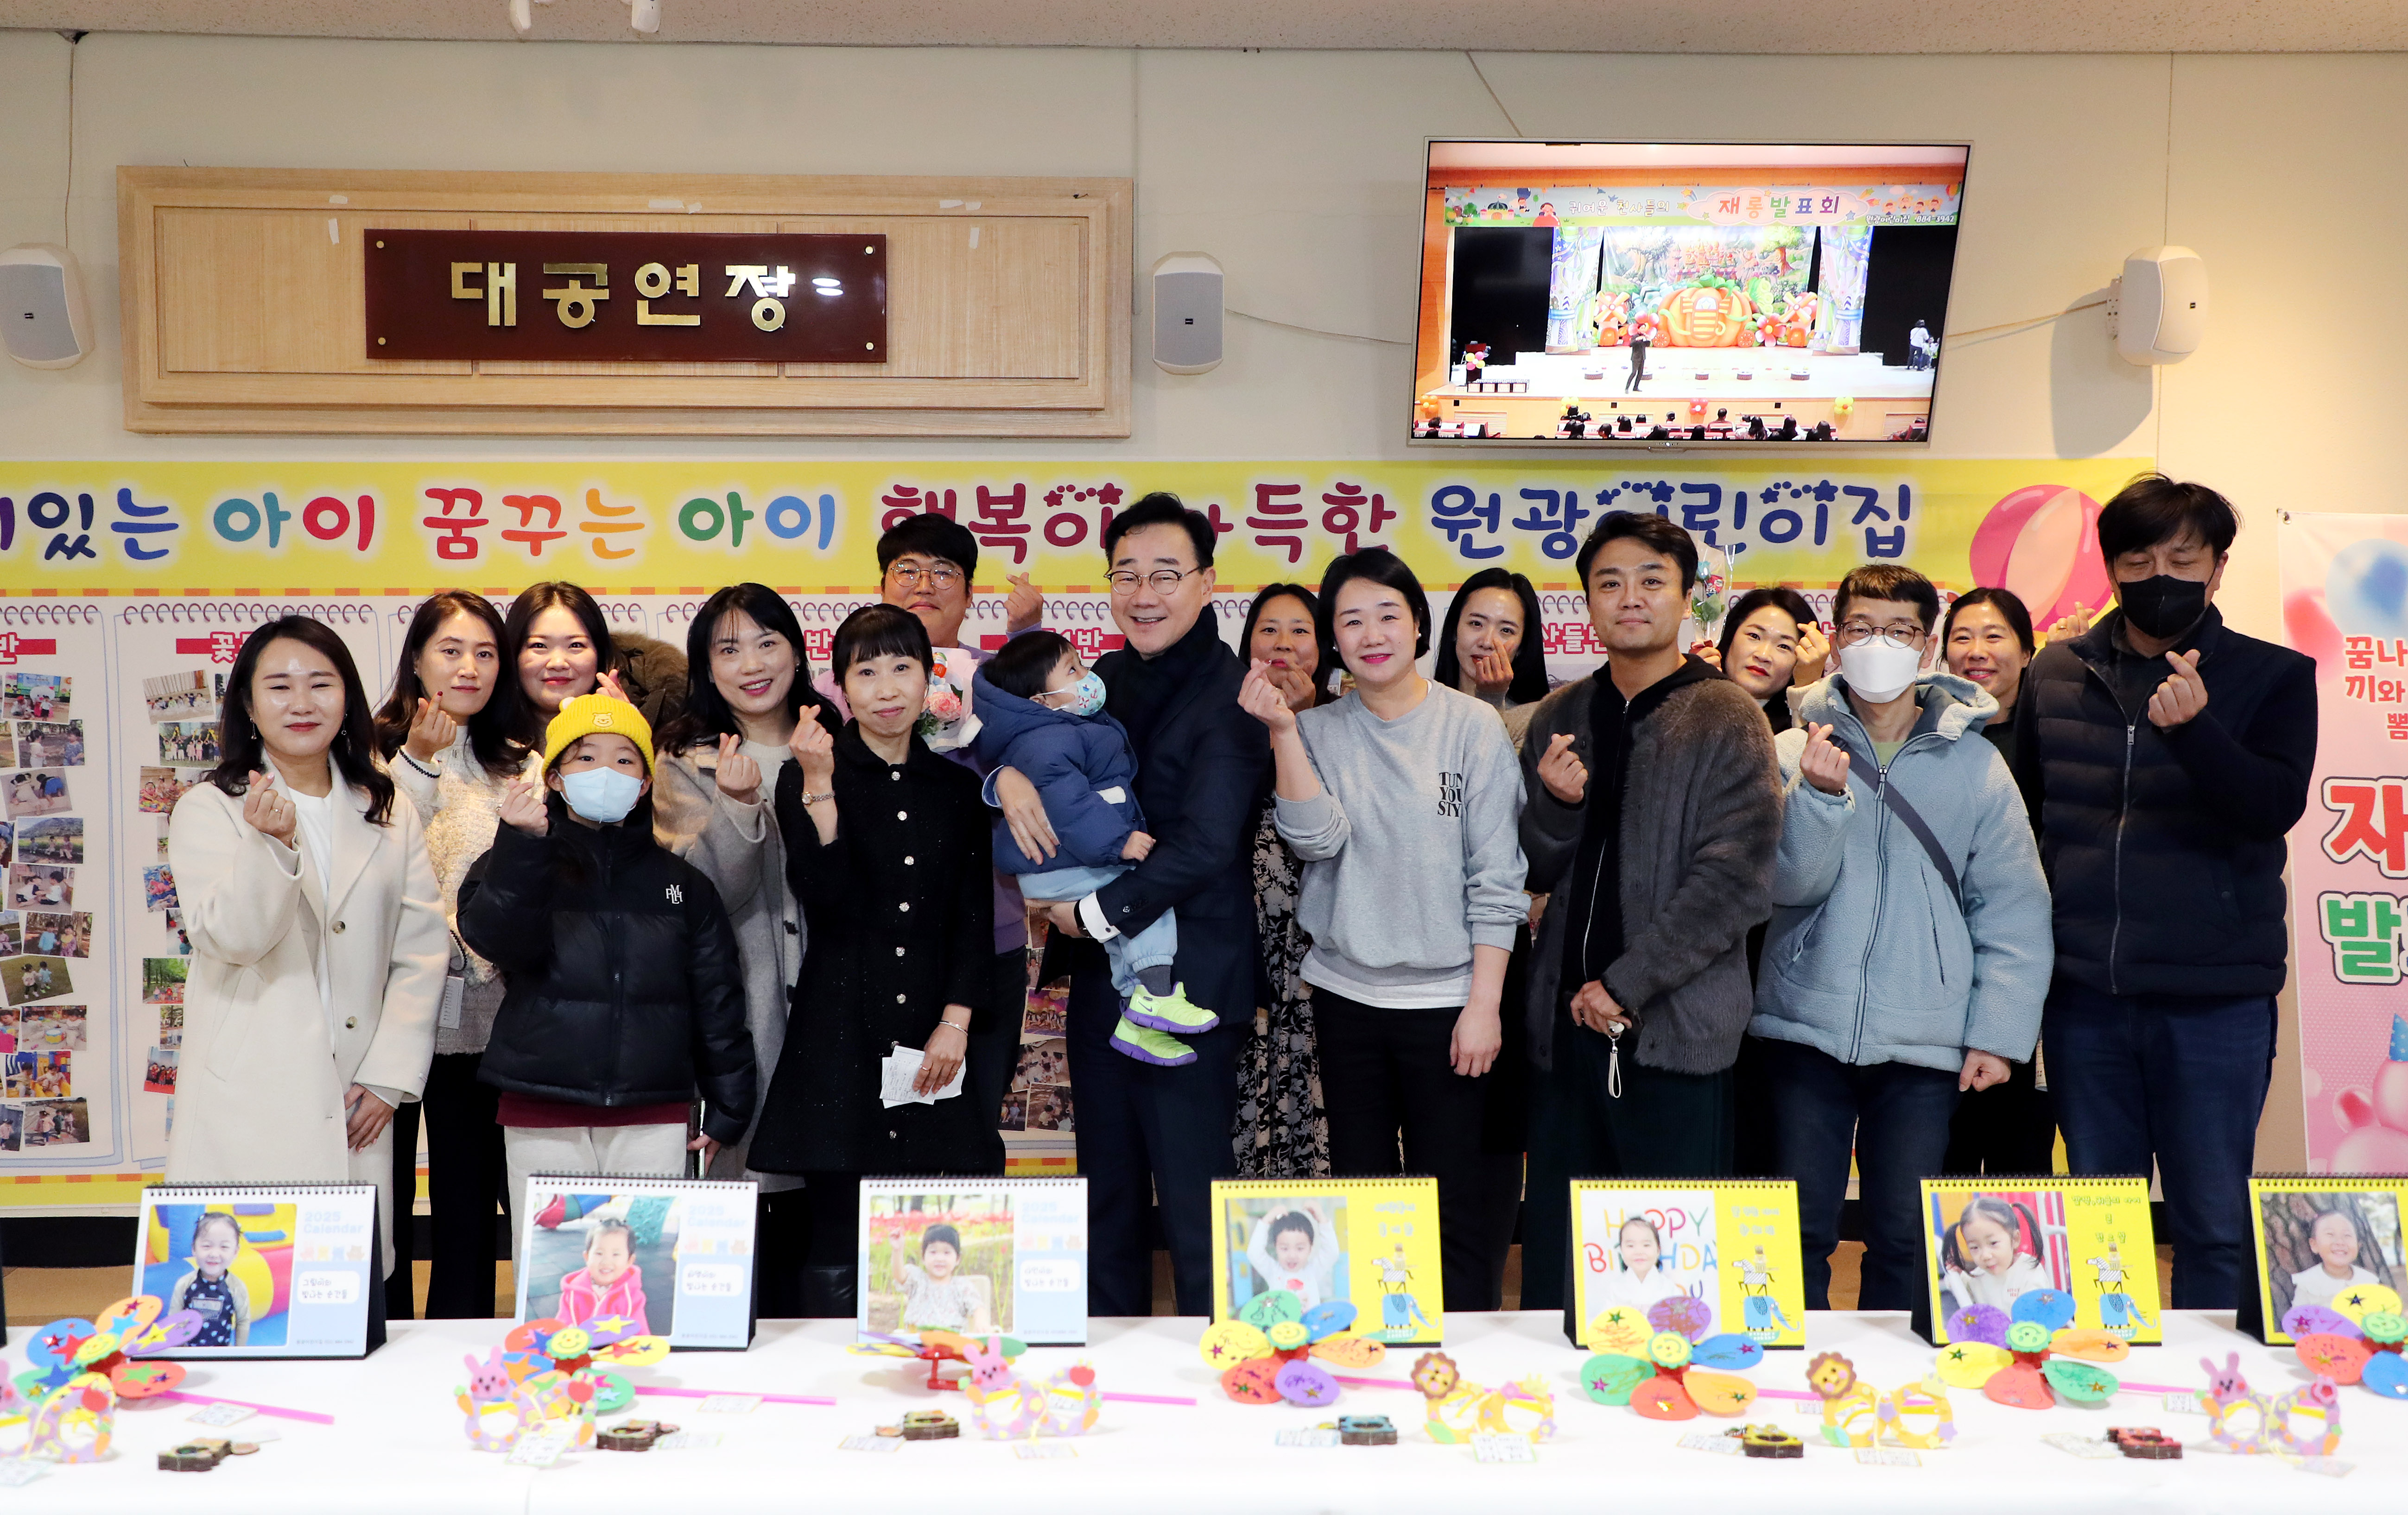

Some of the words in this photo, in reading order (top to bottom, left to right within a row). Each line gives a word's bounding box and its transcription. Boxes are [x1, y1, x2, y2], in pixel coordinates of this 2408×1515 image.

[1569, 201, 1608, 216] 귀여운
[1616, 199, 1670, 217] 천사들의
[451, 261, 796, 333] 대공연장
[213, 492, 375, 551] 아이
[423, 488, 645, 560] 꿈꾸는
[678, 491, 836, 550] 아이
[1431, 480, 1911, 560] 원광린이집
[2345, 675, 2406, 703] 끼와
[303, 1223, 364, 1234] Calendar
[304, 1210, 341, 1223] 2025
[1603, 1206, 1708, 1238] HPPY
